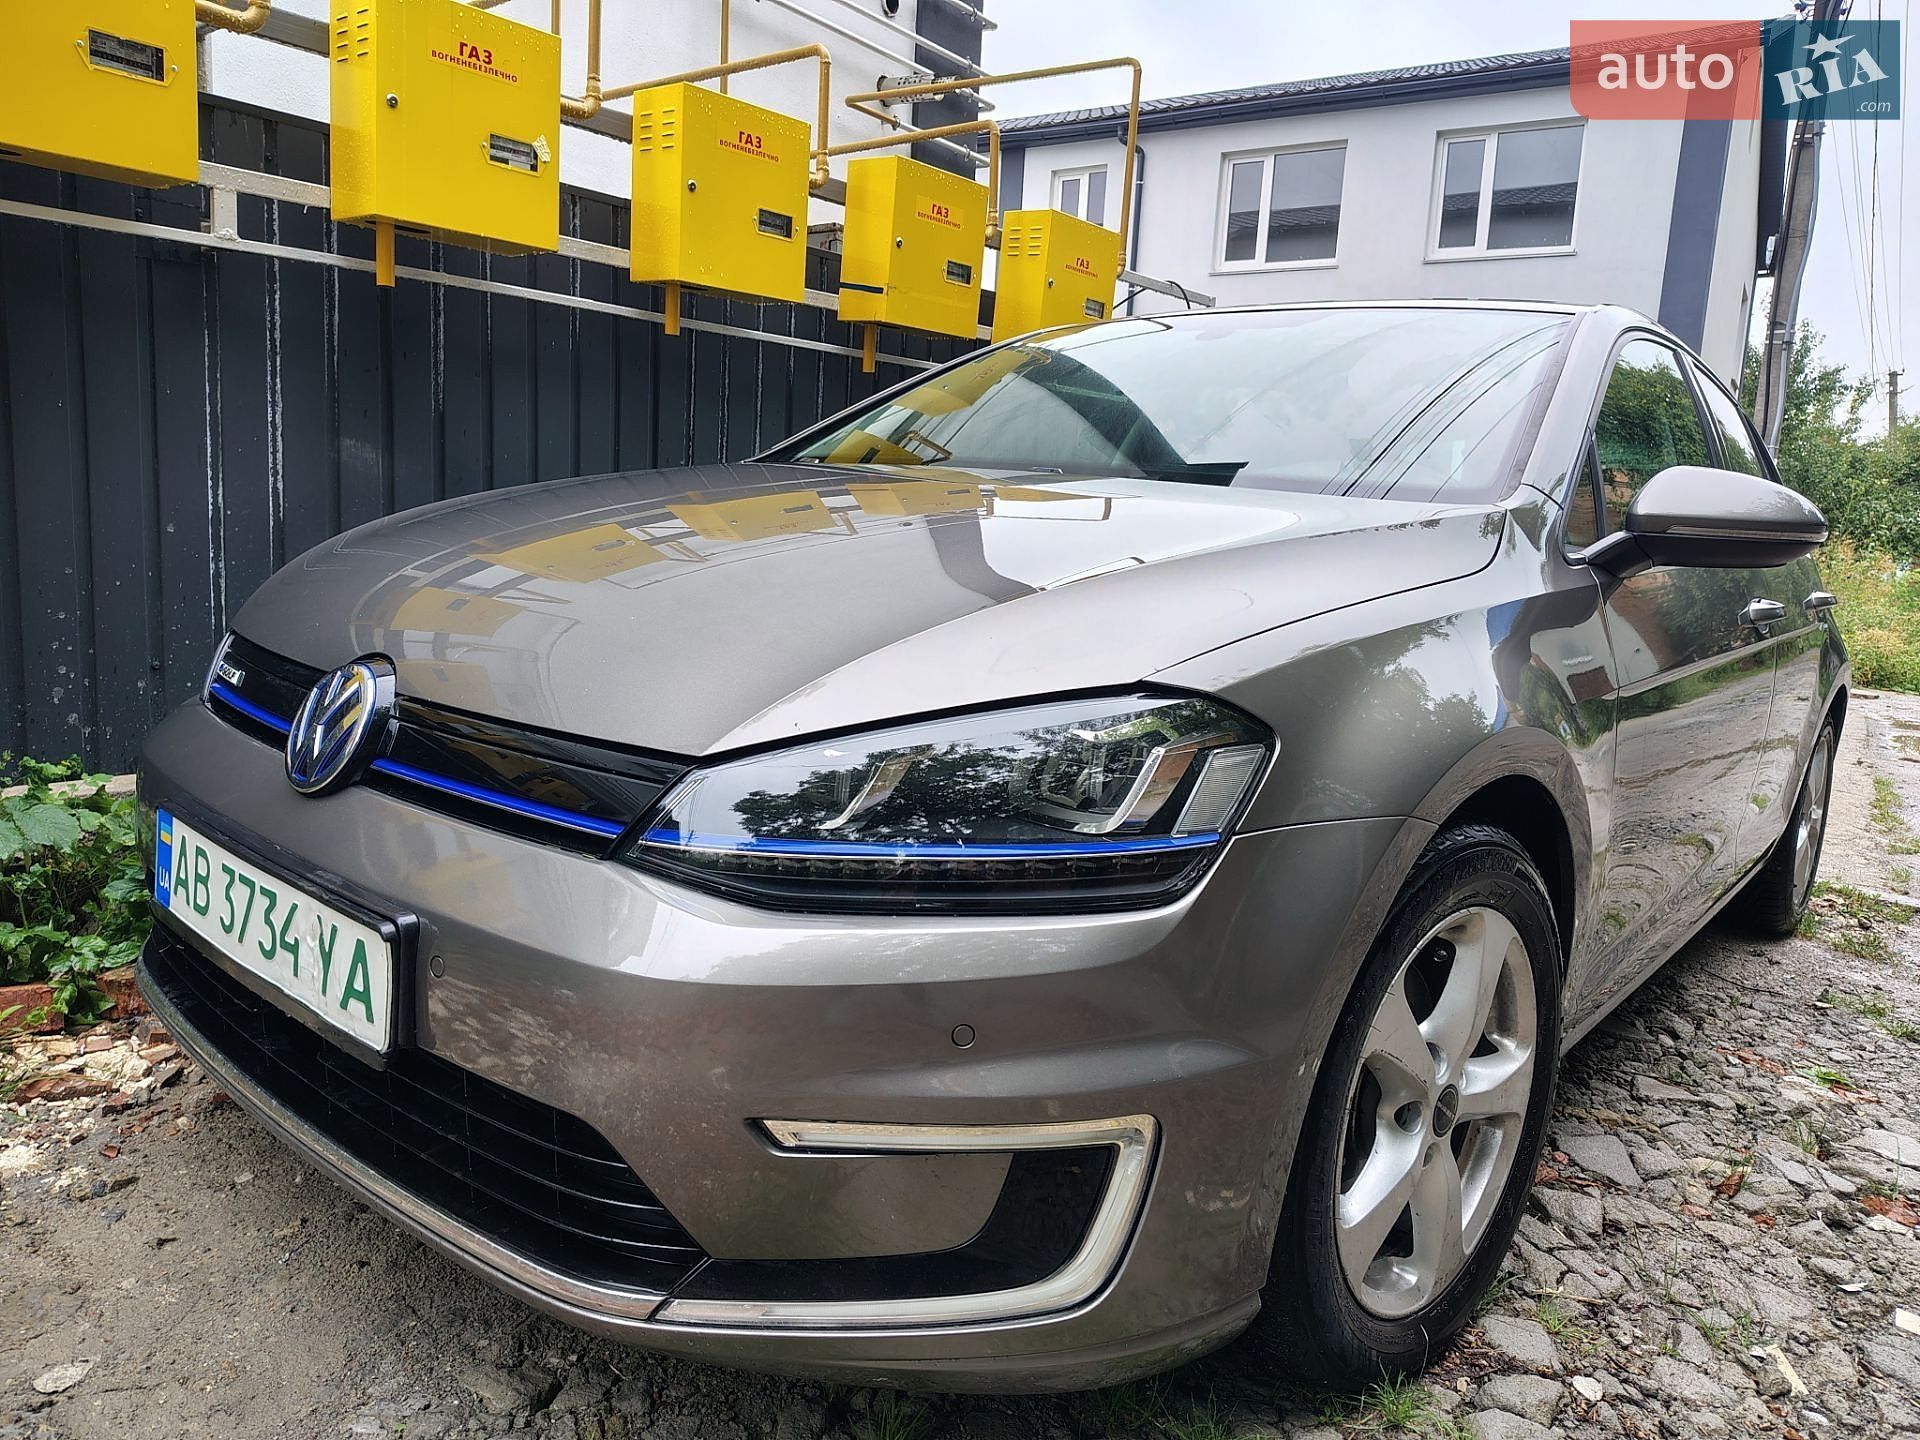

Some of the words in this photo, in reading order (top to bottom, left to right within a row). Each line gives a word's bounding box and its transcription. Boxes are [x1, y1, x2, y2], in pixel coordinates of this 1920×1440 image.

[459, 41, 493, 66] ГАЗ
[431, 49, 519, 83] ВОГНЕНЕБЕЗПЕЧНО
[719, 139, 779, 162] ВОГНЕНЕБЕЗПЕЧНО
[738, 130, 762, 149] ГАЗ
[931, 203, 949, 219] ГАЗ
[1076, 257, 1090, 270] ГАЗ
[159, 866, 171, 892] UA
[173, 834, 211, 917] AB
[219, 862, 300, 978] 3734
[316, 914, 375, 1024] YA
